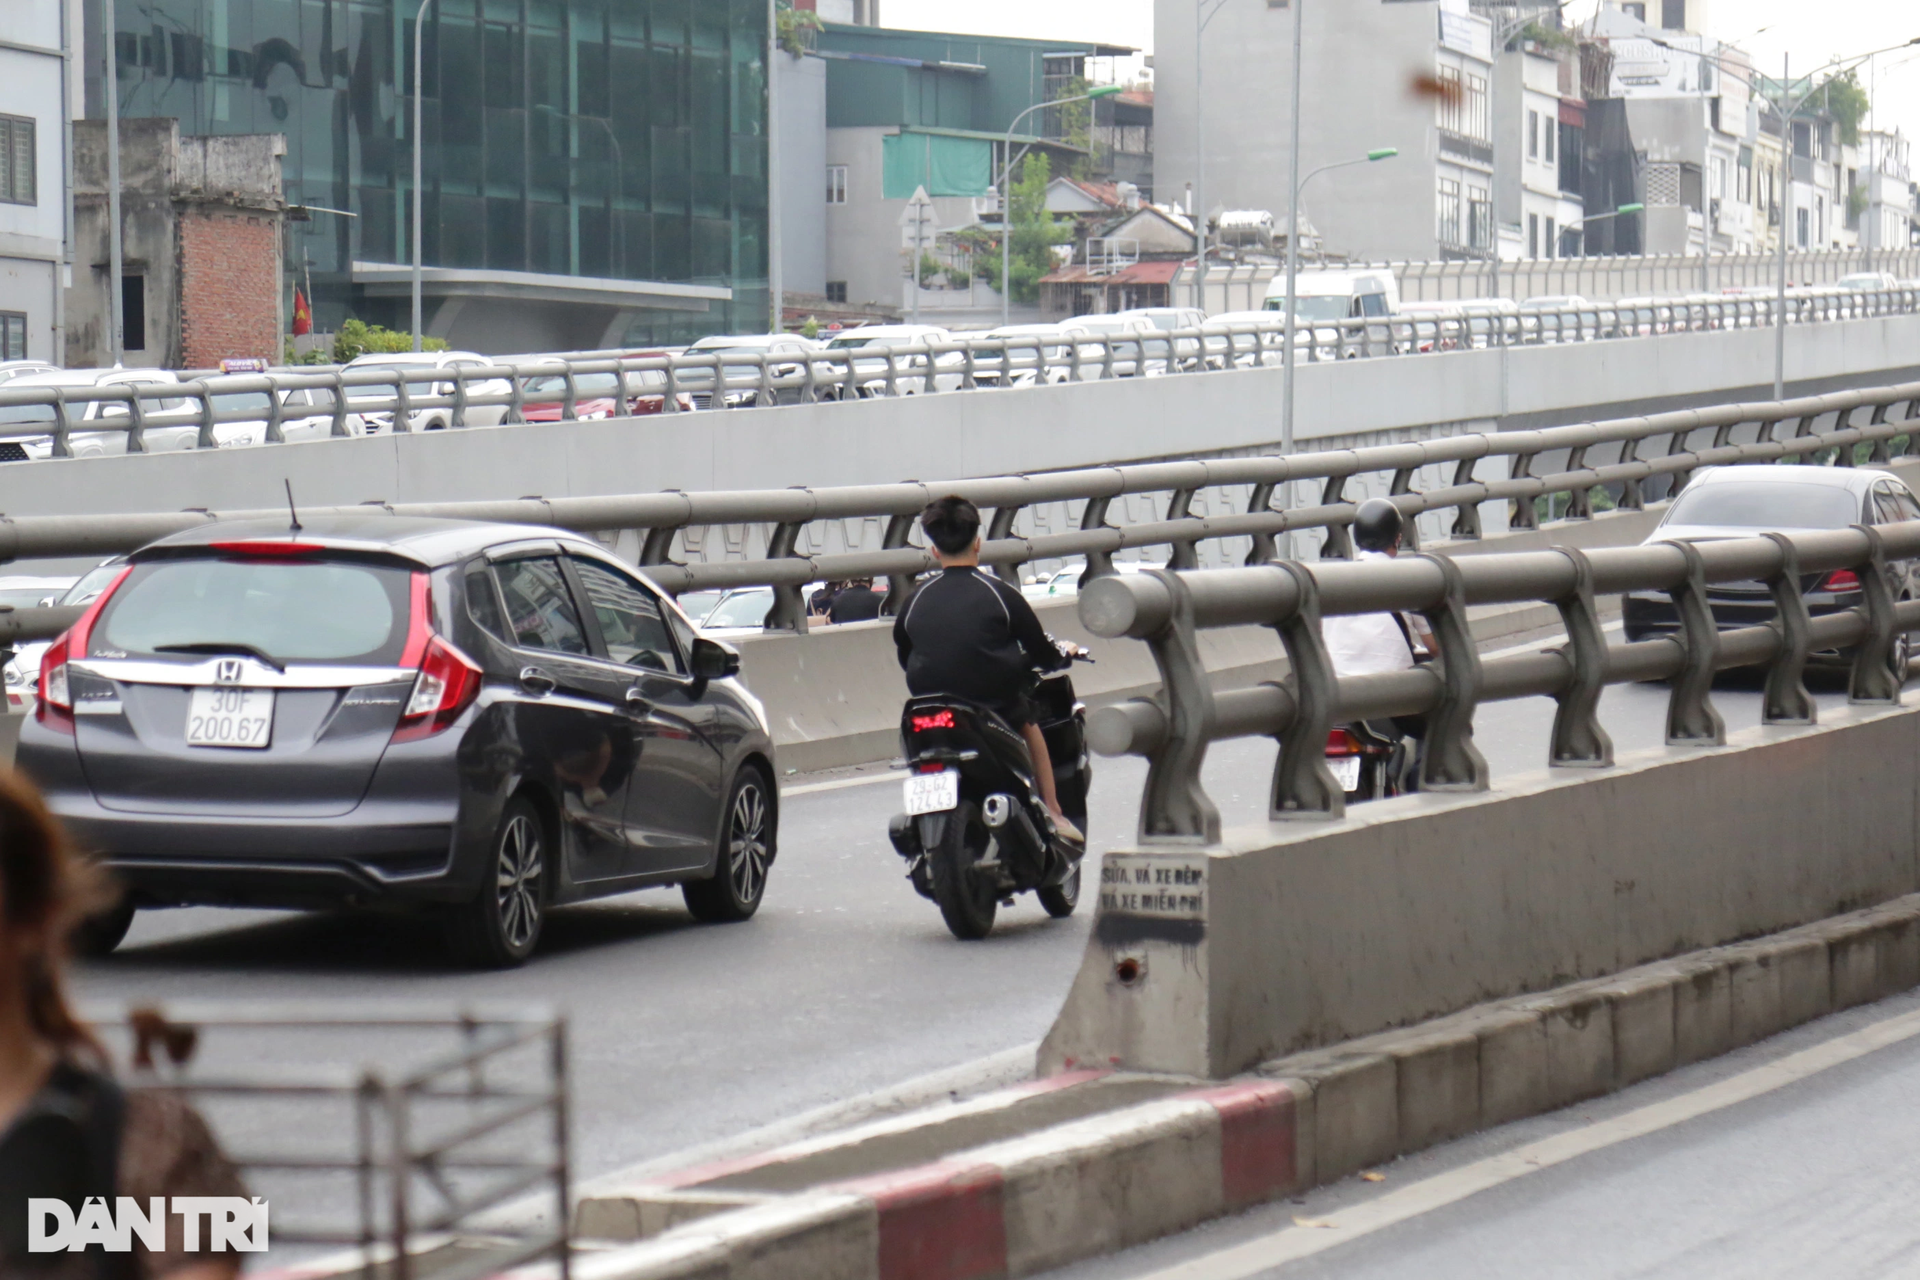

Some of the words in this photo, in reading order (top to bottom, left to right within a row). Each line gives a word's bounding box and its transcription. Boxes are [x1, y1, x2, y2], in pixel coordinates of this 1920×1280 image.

[210, 688, 250, 714] 30F
[190, 715, 266, 742] 200.67
[1156, 868, 1172, 885] XE
[1122, 894, 1137, 910] XE
